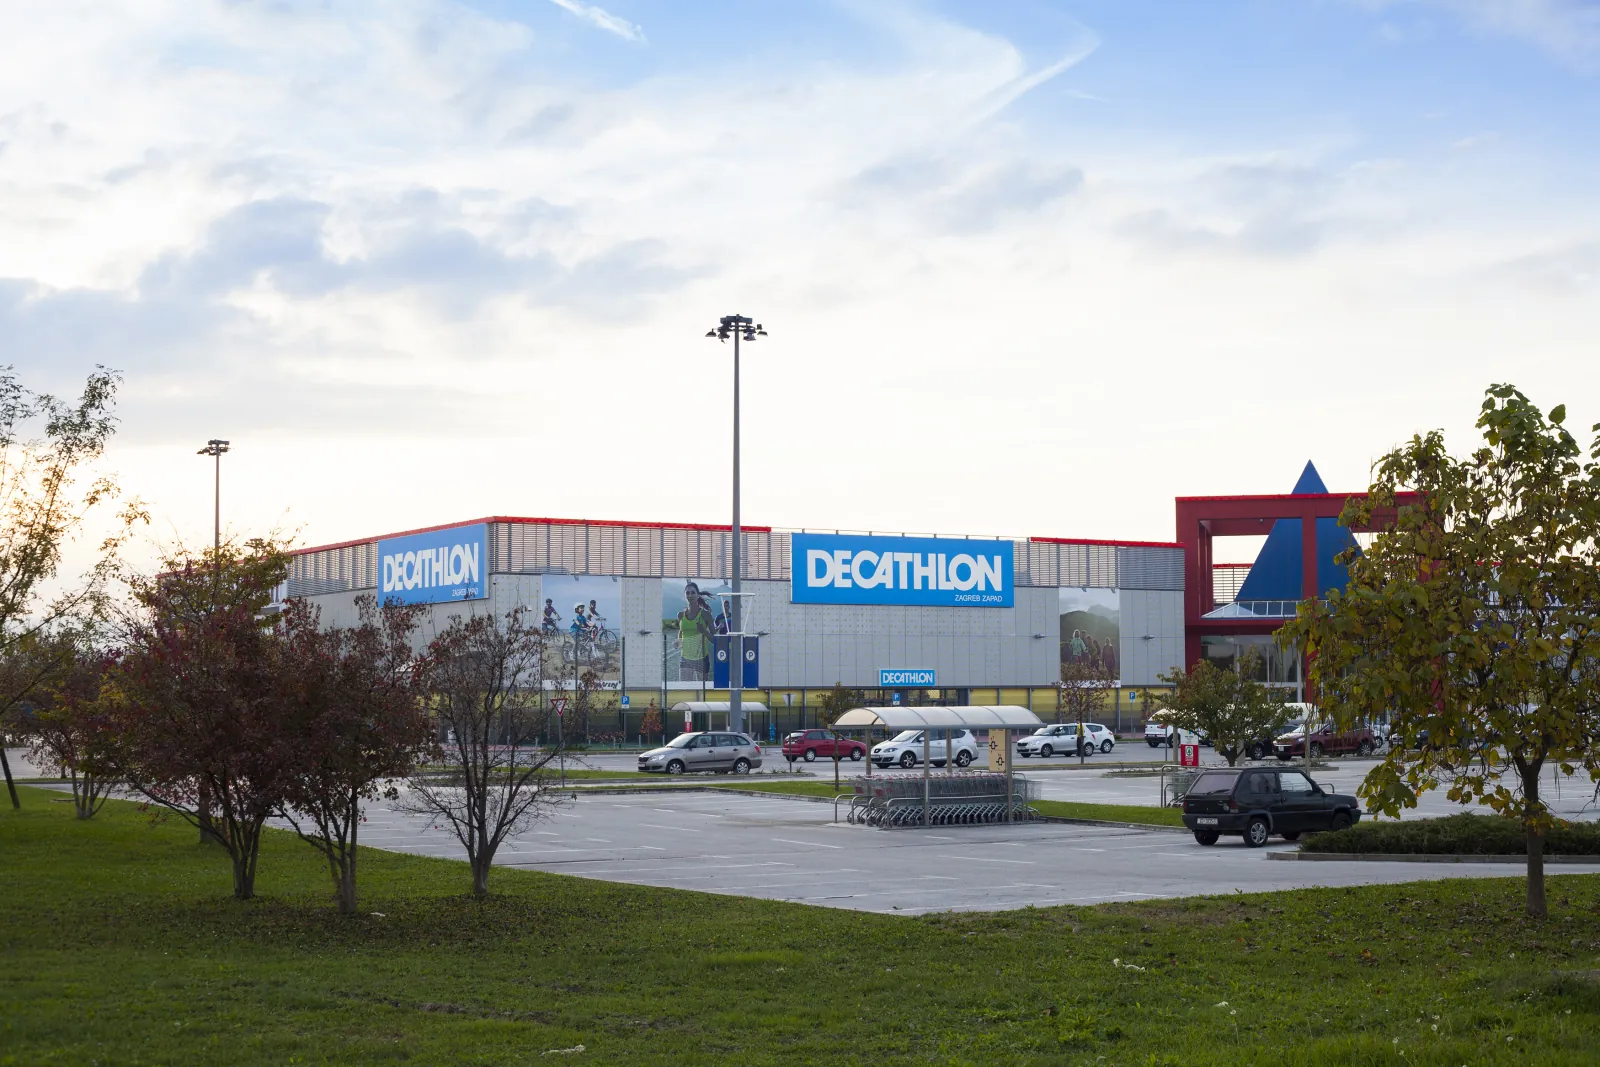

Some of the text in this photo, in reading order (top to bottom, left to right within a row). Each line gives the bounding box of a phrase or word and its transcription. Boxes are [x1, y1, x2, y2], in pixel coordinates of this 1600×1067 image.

[383, 542, 479, 593] DECATHLON
[806, 549, 1003, 592] DECATHLON
[954, 594, 1003, 603] ZAGREB ZAPAD
[882, 672, 934, 684] DECATHLON
